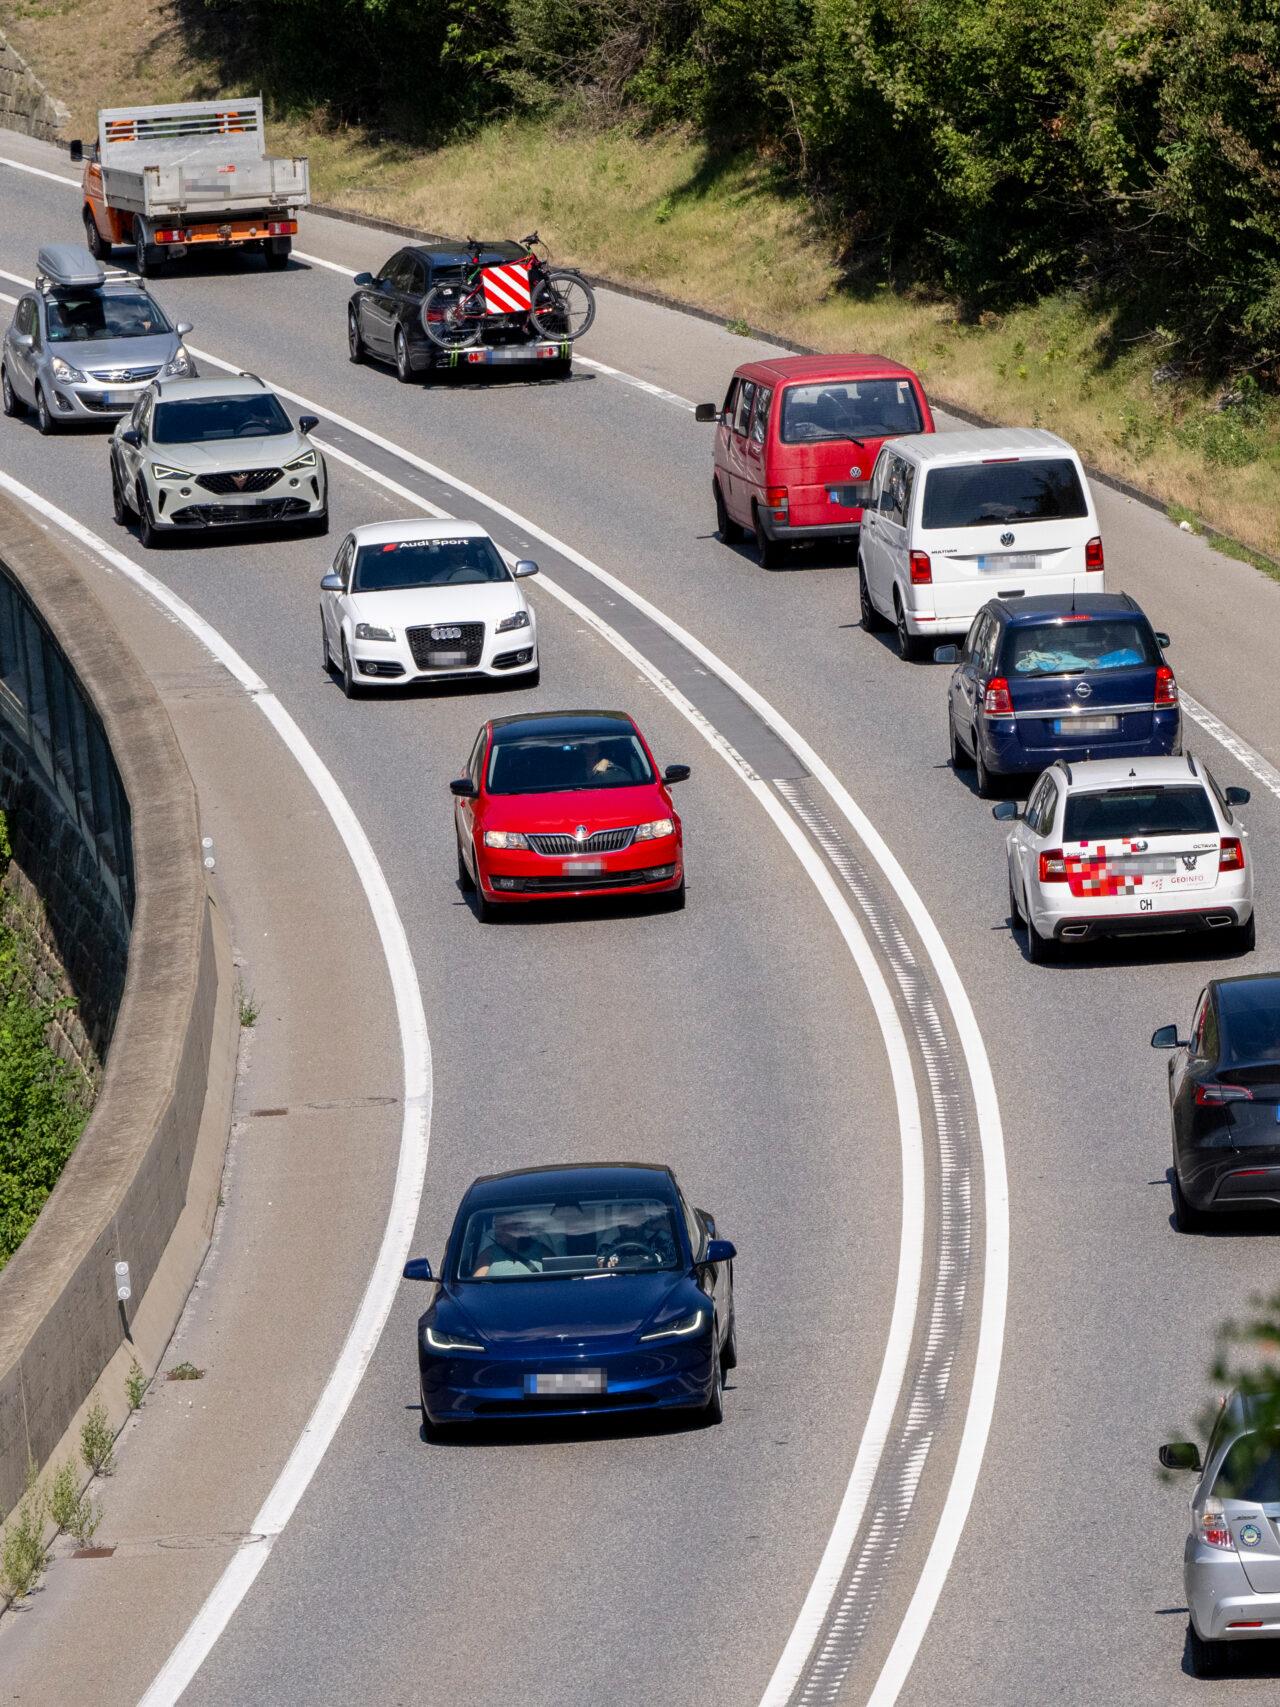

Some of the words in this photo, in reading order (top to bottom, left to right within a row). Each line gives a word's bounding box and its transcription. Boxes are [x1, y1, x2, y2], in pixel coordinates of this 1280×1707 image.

[399, 541, 429, 549] Audi
[432, 539, 469, 547] Sport
[1170, 875, 1204, 884] GEOINFO
[1139, 898, 1153, 911] CH
